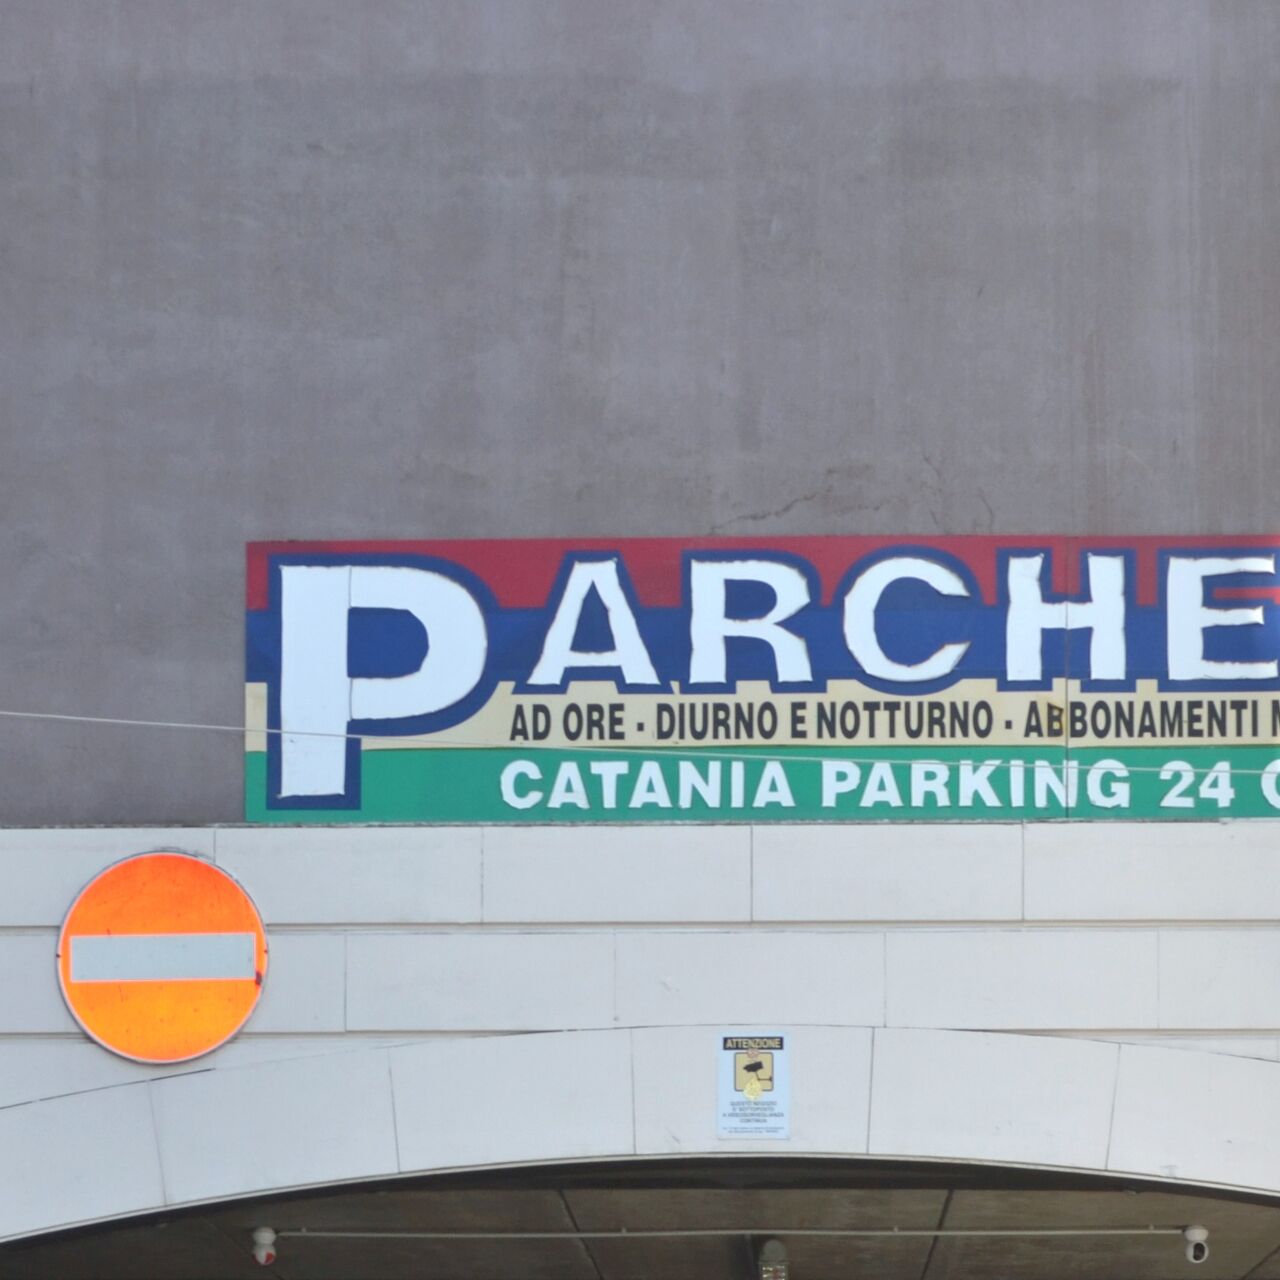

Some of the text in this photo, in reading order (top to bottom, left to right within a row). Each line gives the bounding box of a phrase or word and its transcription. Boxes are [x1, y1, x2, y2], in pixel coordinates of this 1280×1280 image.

[510, 704, 553, 742] AD
[561, 702, 625, 742] ORE
[656, 701, 775, 741] DIURNO
[791, 701, 808, 740] E
[825, 700, 993, 740] NOTTURNO
[1023, 699, 1260, 739] ABBONAMENTI
[499, 759, 796, 811] CATANIA
[821, 758, 1131, 811] PARKING
[1157, 758, 1235, 810] 24
[725, 1037, 782, 1049] ATTENZIONE
